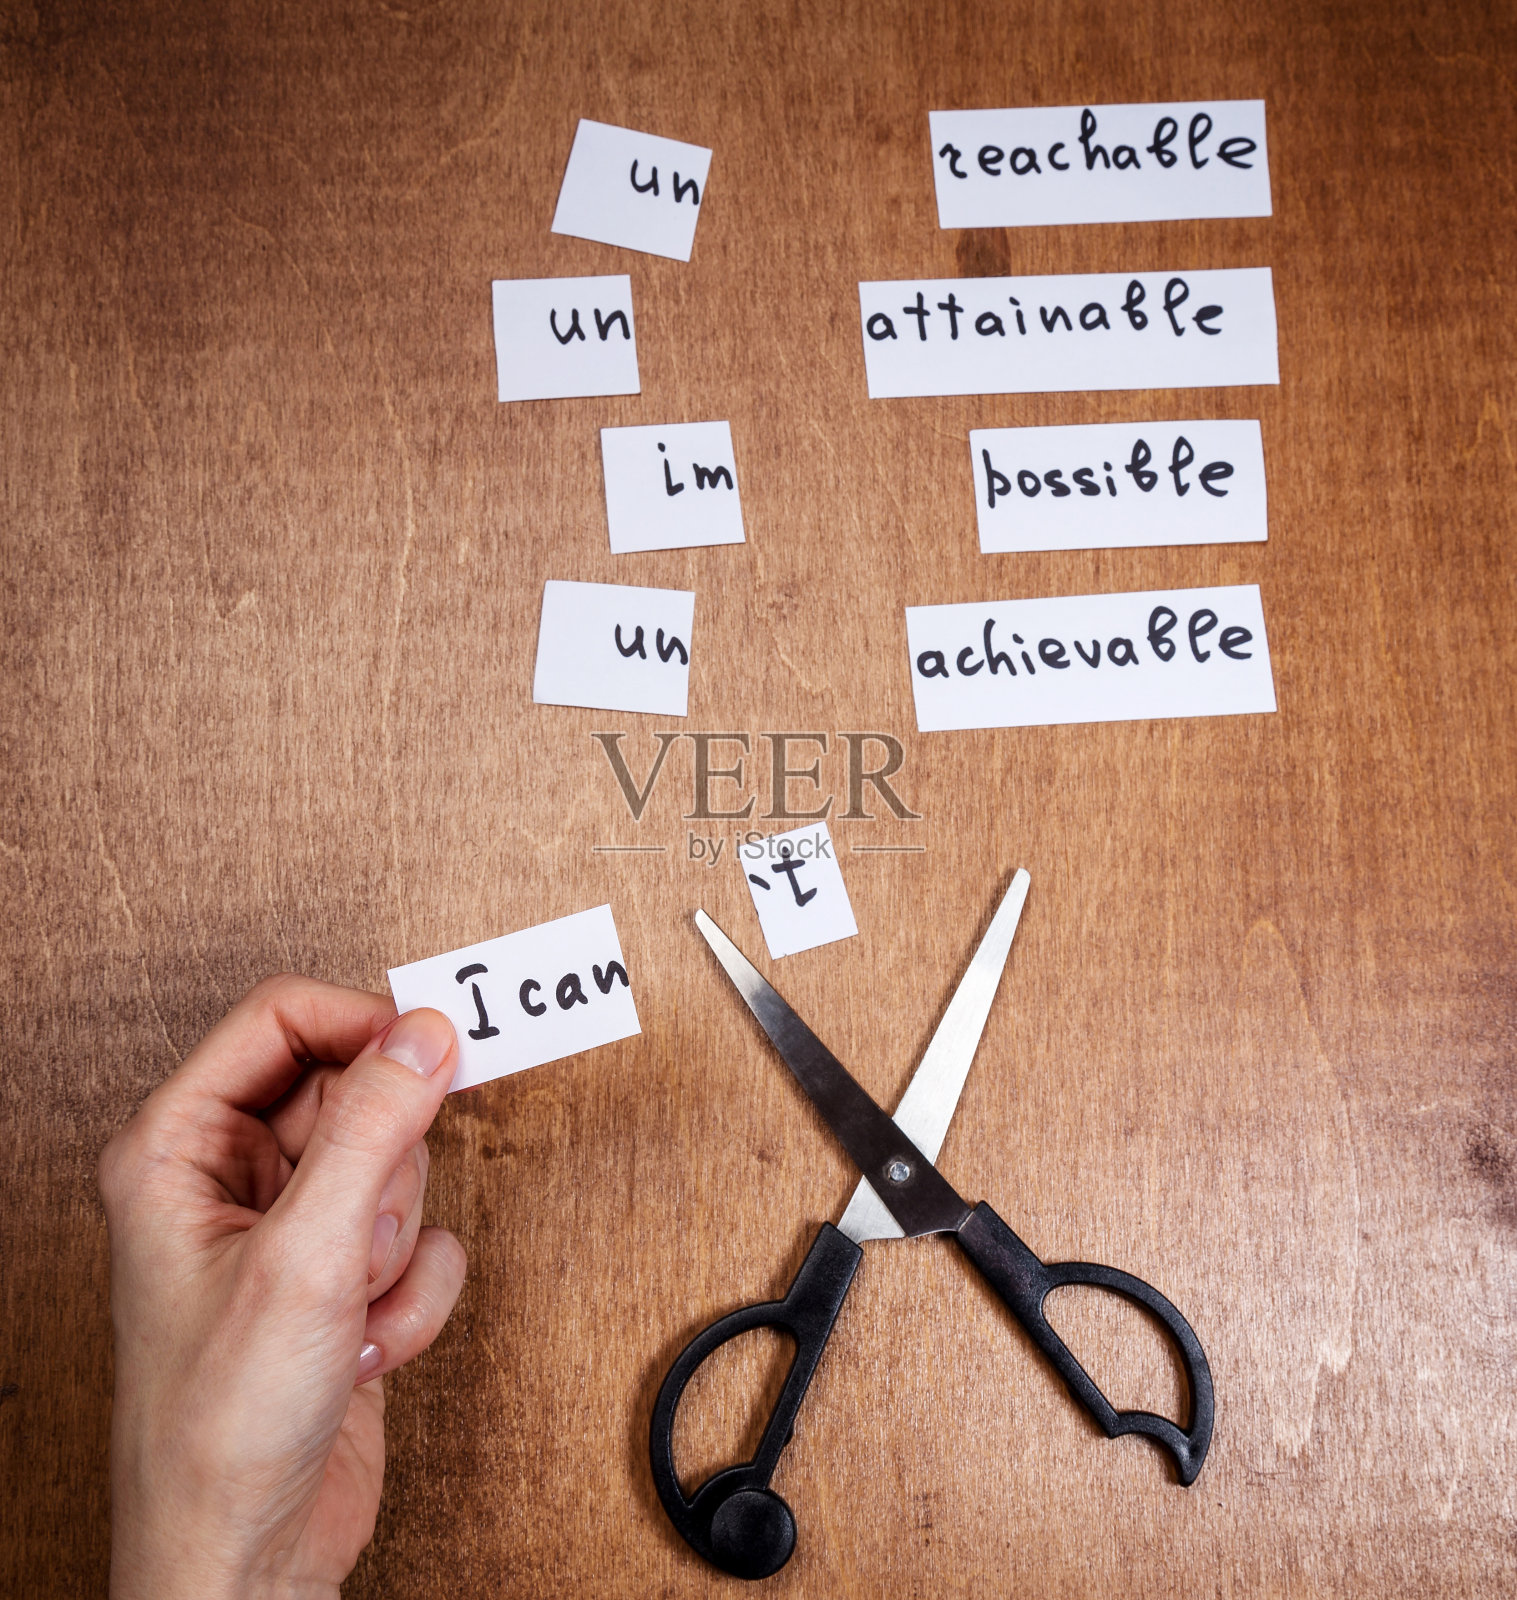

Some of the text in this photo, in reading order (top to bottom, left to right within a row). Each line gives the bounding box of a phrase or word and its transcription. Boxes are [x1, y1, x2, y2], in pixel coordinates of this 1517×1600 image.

[938, 108, 1257, 179] reachable
[630, 159, 700, 206] un
[549, 308, 631, 345] un
[866, 277, 1224, 342] attainable
[657, 442, 734, 497] im
[982, 435, 1235, 509] possible
[614, 624, 690, 666] un
[916, 605, 1254, 679] achievable
[455, 960, 630, 1042] I can
